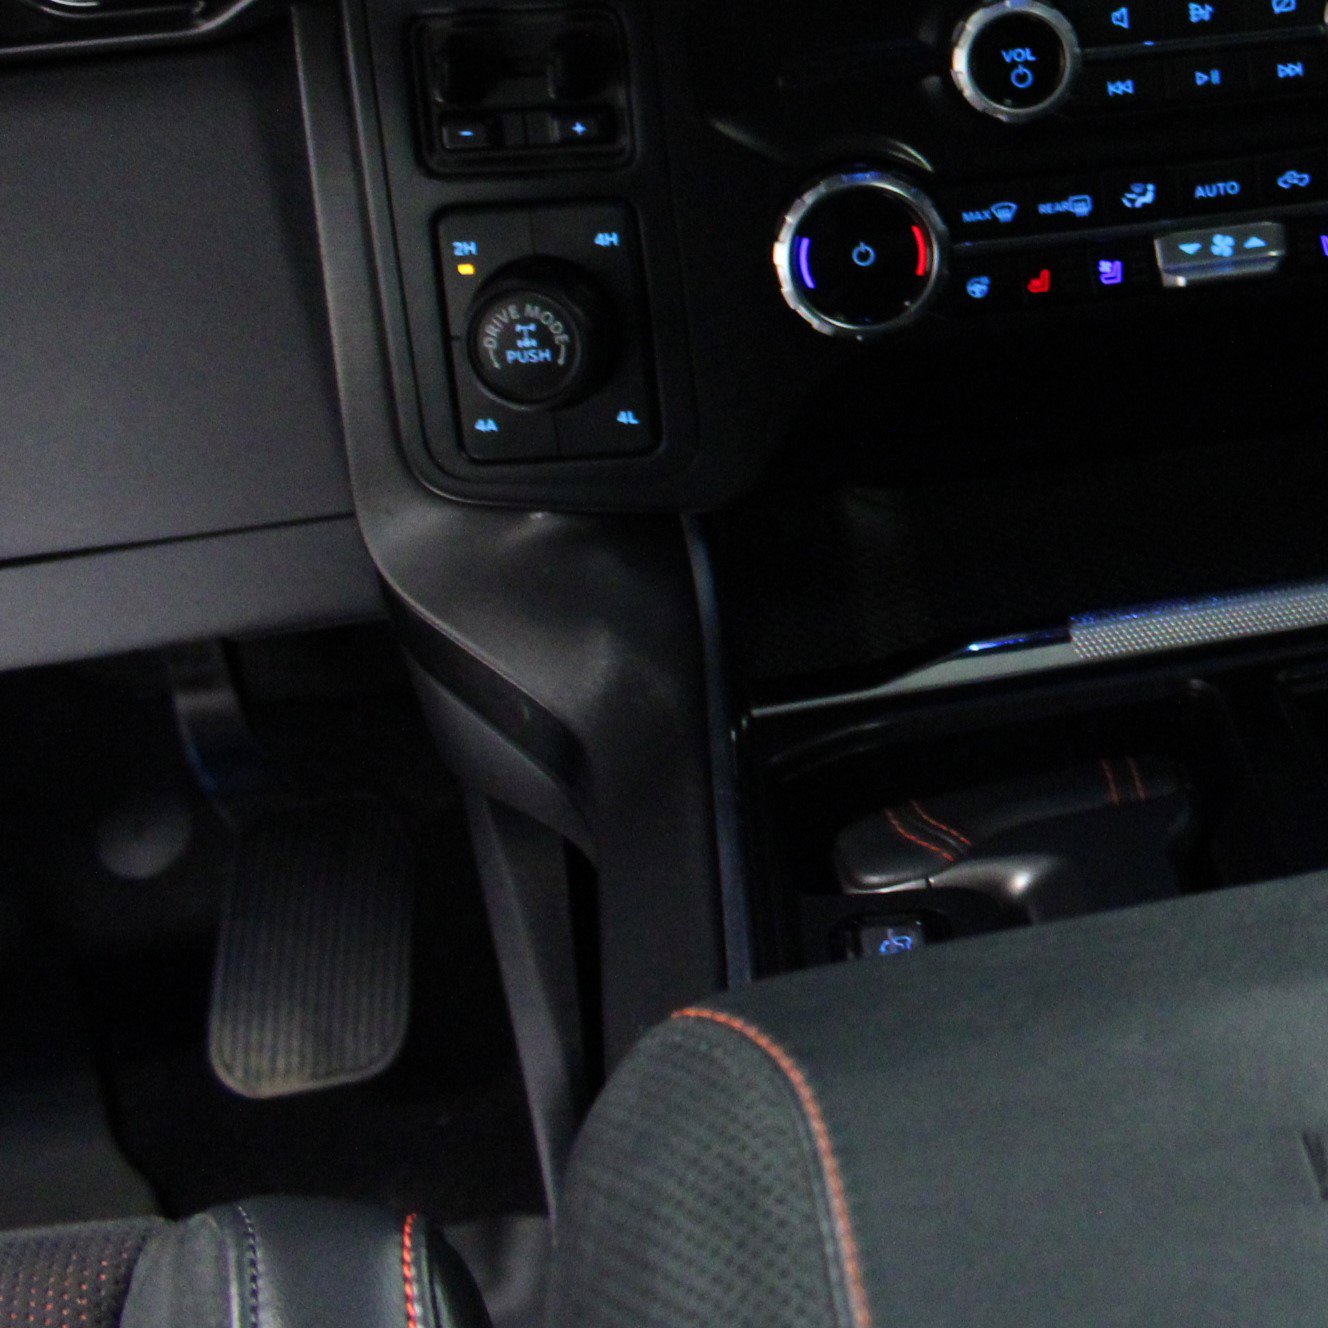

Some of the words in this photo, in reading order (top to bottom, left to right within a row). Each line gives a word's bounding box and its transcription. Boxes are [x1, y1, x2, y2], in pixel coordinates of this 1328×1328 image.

[1001, 47, 1036, 65] VOL
[1194, 181, 1239, 199] AUTO
[962, 209, 992, 222] MAX
[1038, 200, 1071, 215] REAR
[593, 232, 620, 248] 4H
[452, 240, 479, 257] 2H
[483, 304, 521, 349] DRIVE
[524, 303, 571, 346] MODE
[505, 348, 553, 365] PUSH
[473, 417, 500, 433] 4A
[616, 410, 641, 425] 4L
